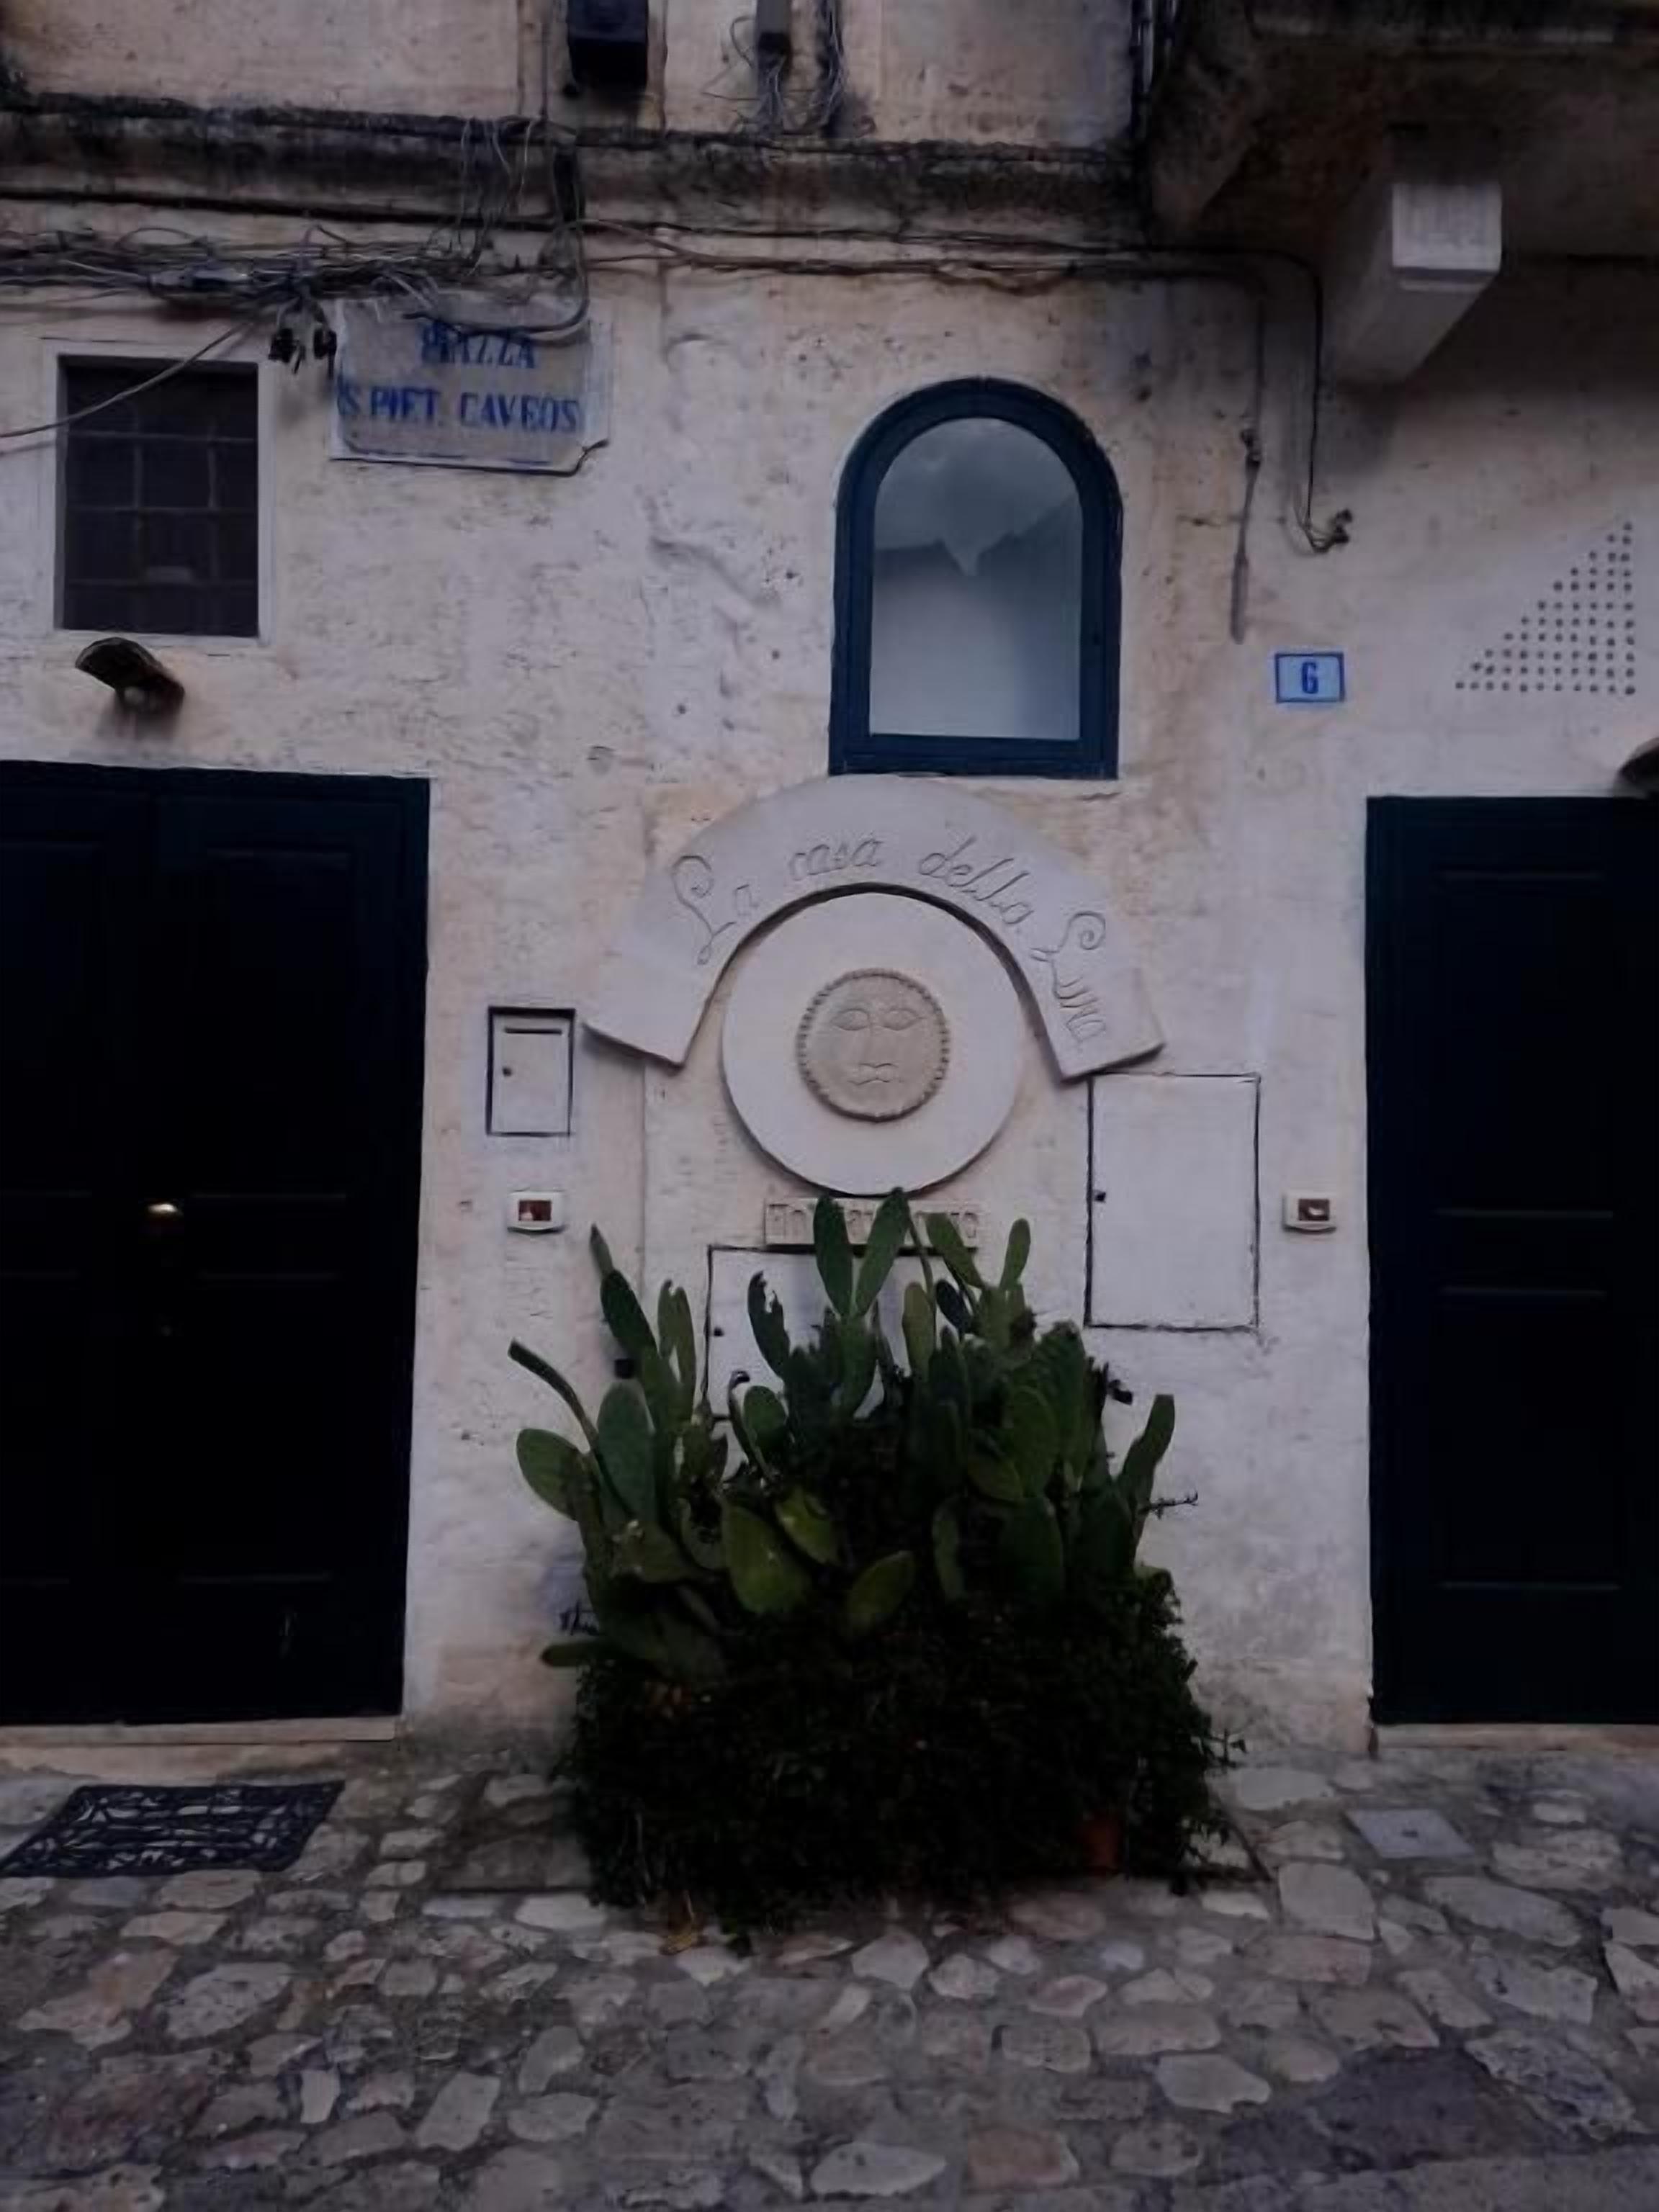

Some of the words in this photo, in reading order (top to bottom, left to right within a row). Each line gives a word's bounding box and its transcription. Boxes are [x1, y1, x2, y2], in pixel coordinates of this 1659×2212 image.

[1301, 661, 1319, 695] 6
[670, 855, 760, 966] La
[788, 837, 884, 881] casa
[918, 834, 1035, 925] della
[1028, 909, 1107, 1043] Luna
